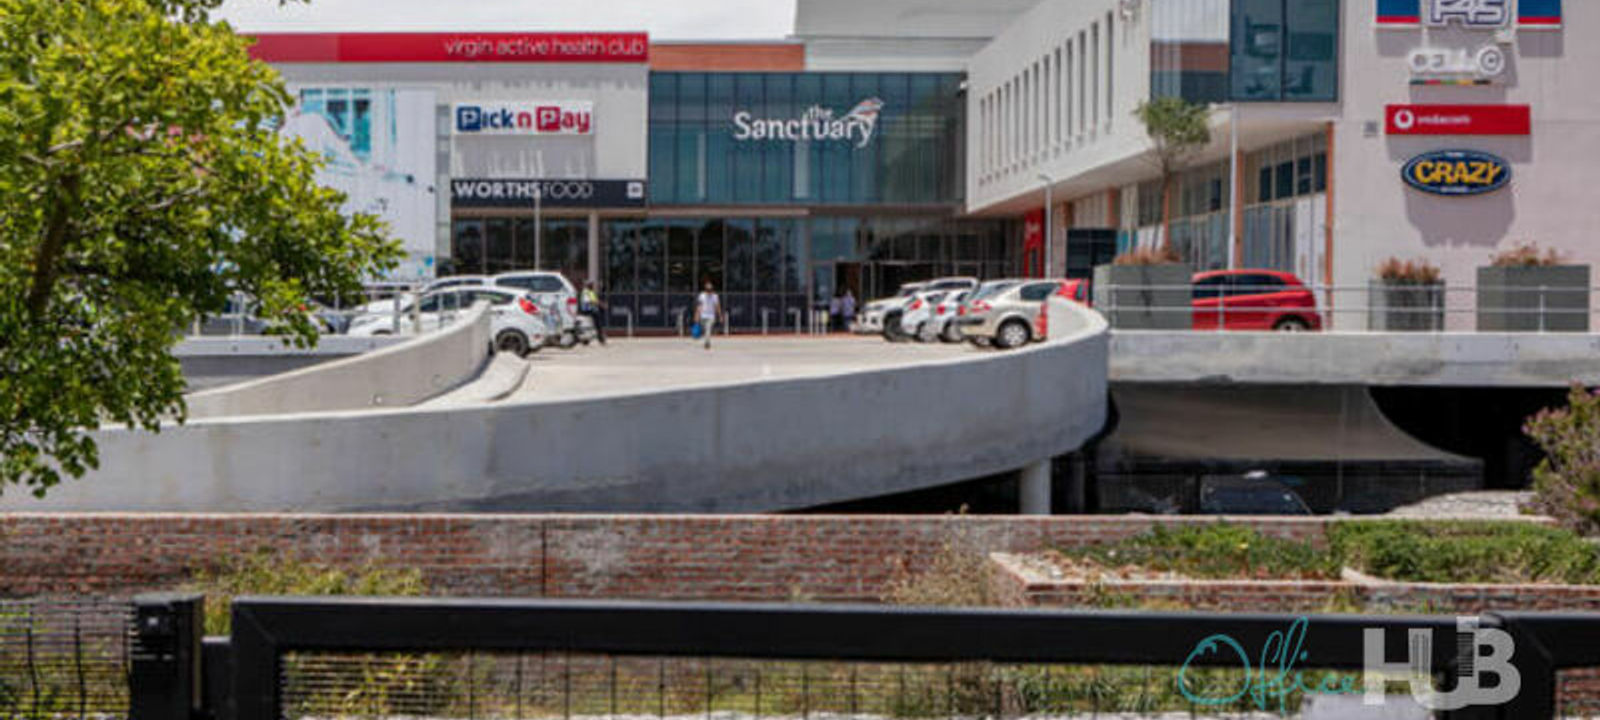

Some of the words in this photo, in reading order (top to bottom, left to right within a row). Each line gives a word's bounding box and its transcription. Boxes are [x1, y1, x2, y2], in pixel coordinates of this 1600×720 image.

[445, 38, 493, 57] virgin
[496, 38, 549, 55] active
[552, 38, 605, 55] health
[608, 38, 645, 55] club
[456, 106, 514, 132] Pick
[517, 112, 532, 128] n
[536, 106, 591, 133] Pay
[808, 104, 833, 119] the
[734, 110, 872, 149] Sanctuary
[1414, 160, 1501, 184] CRAZY
[451, 181, 541, 198] WORTHS
